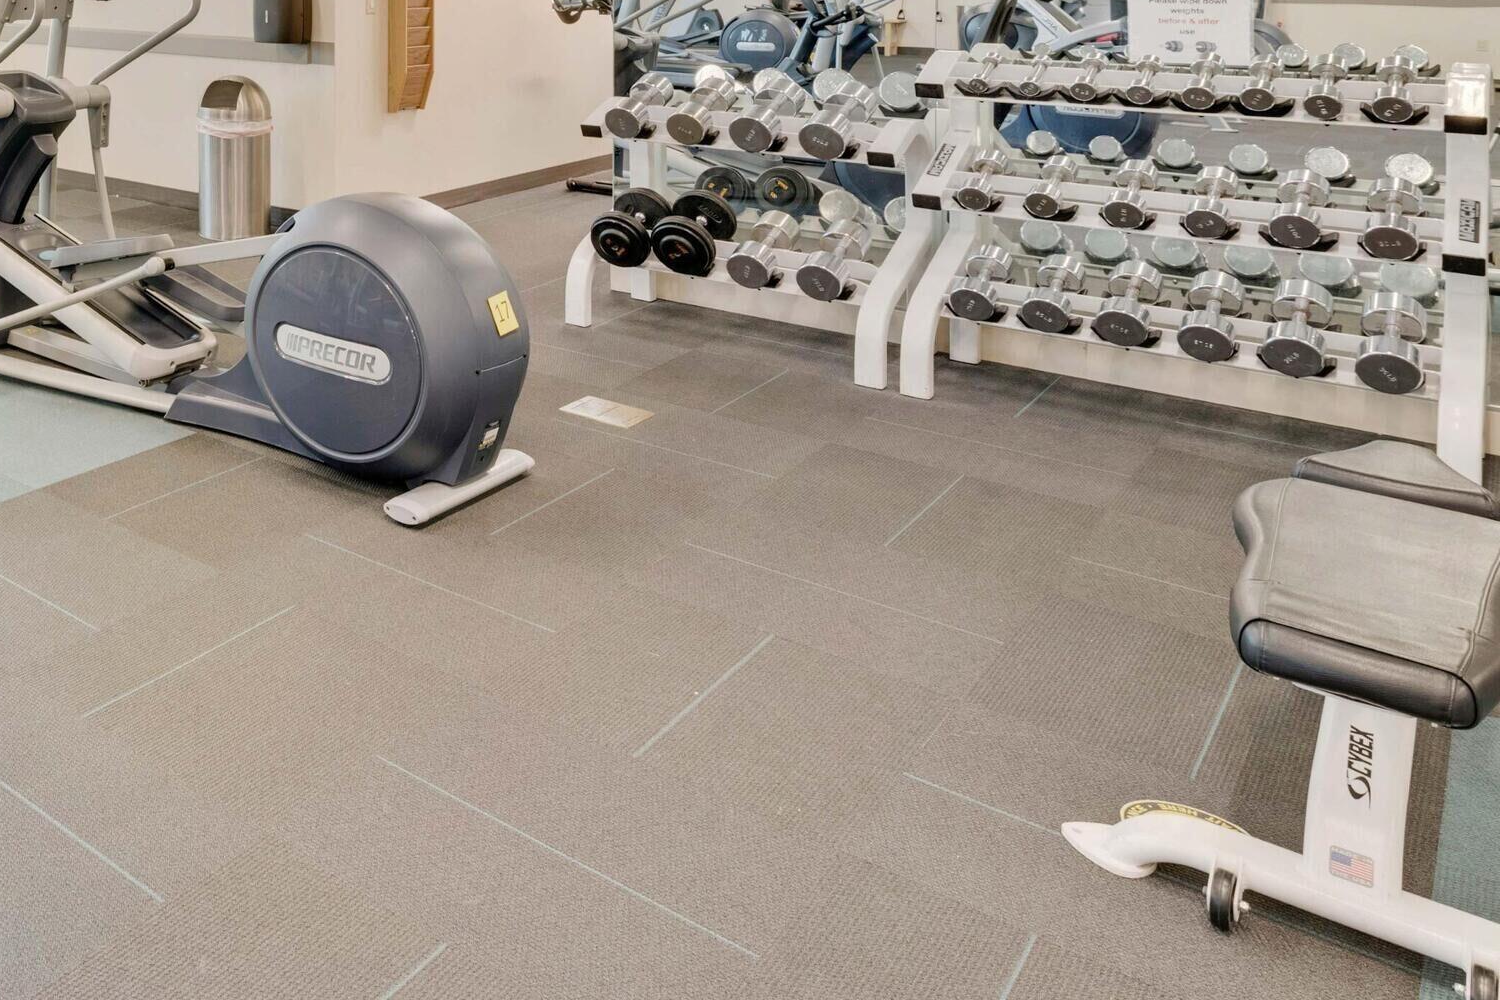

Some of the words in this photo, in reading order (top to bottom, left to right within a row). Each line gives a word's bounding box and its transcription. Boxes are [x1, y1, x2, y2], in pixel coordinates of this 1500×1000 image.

[1158, 17, 1187, 25] before
[1198, 17, 1220, 25] after
[1170, 8, 1205, 16] weights
[495, 301, 511, 322] 17
[297, 336, 376, 374] PRECOR
[1348, 725, 1374, 778] CYBEX
